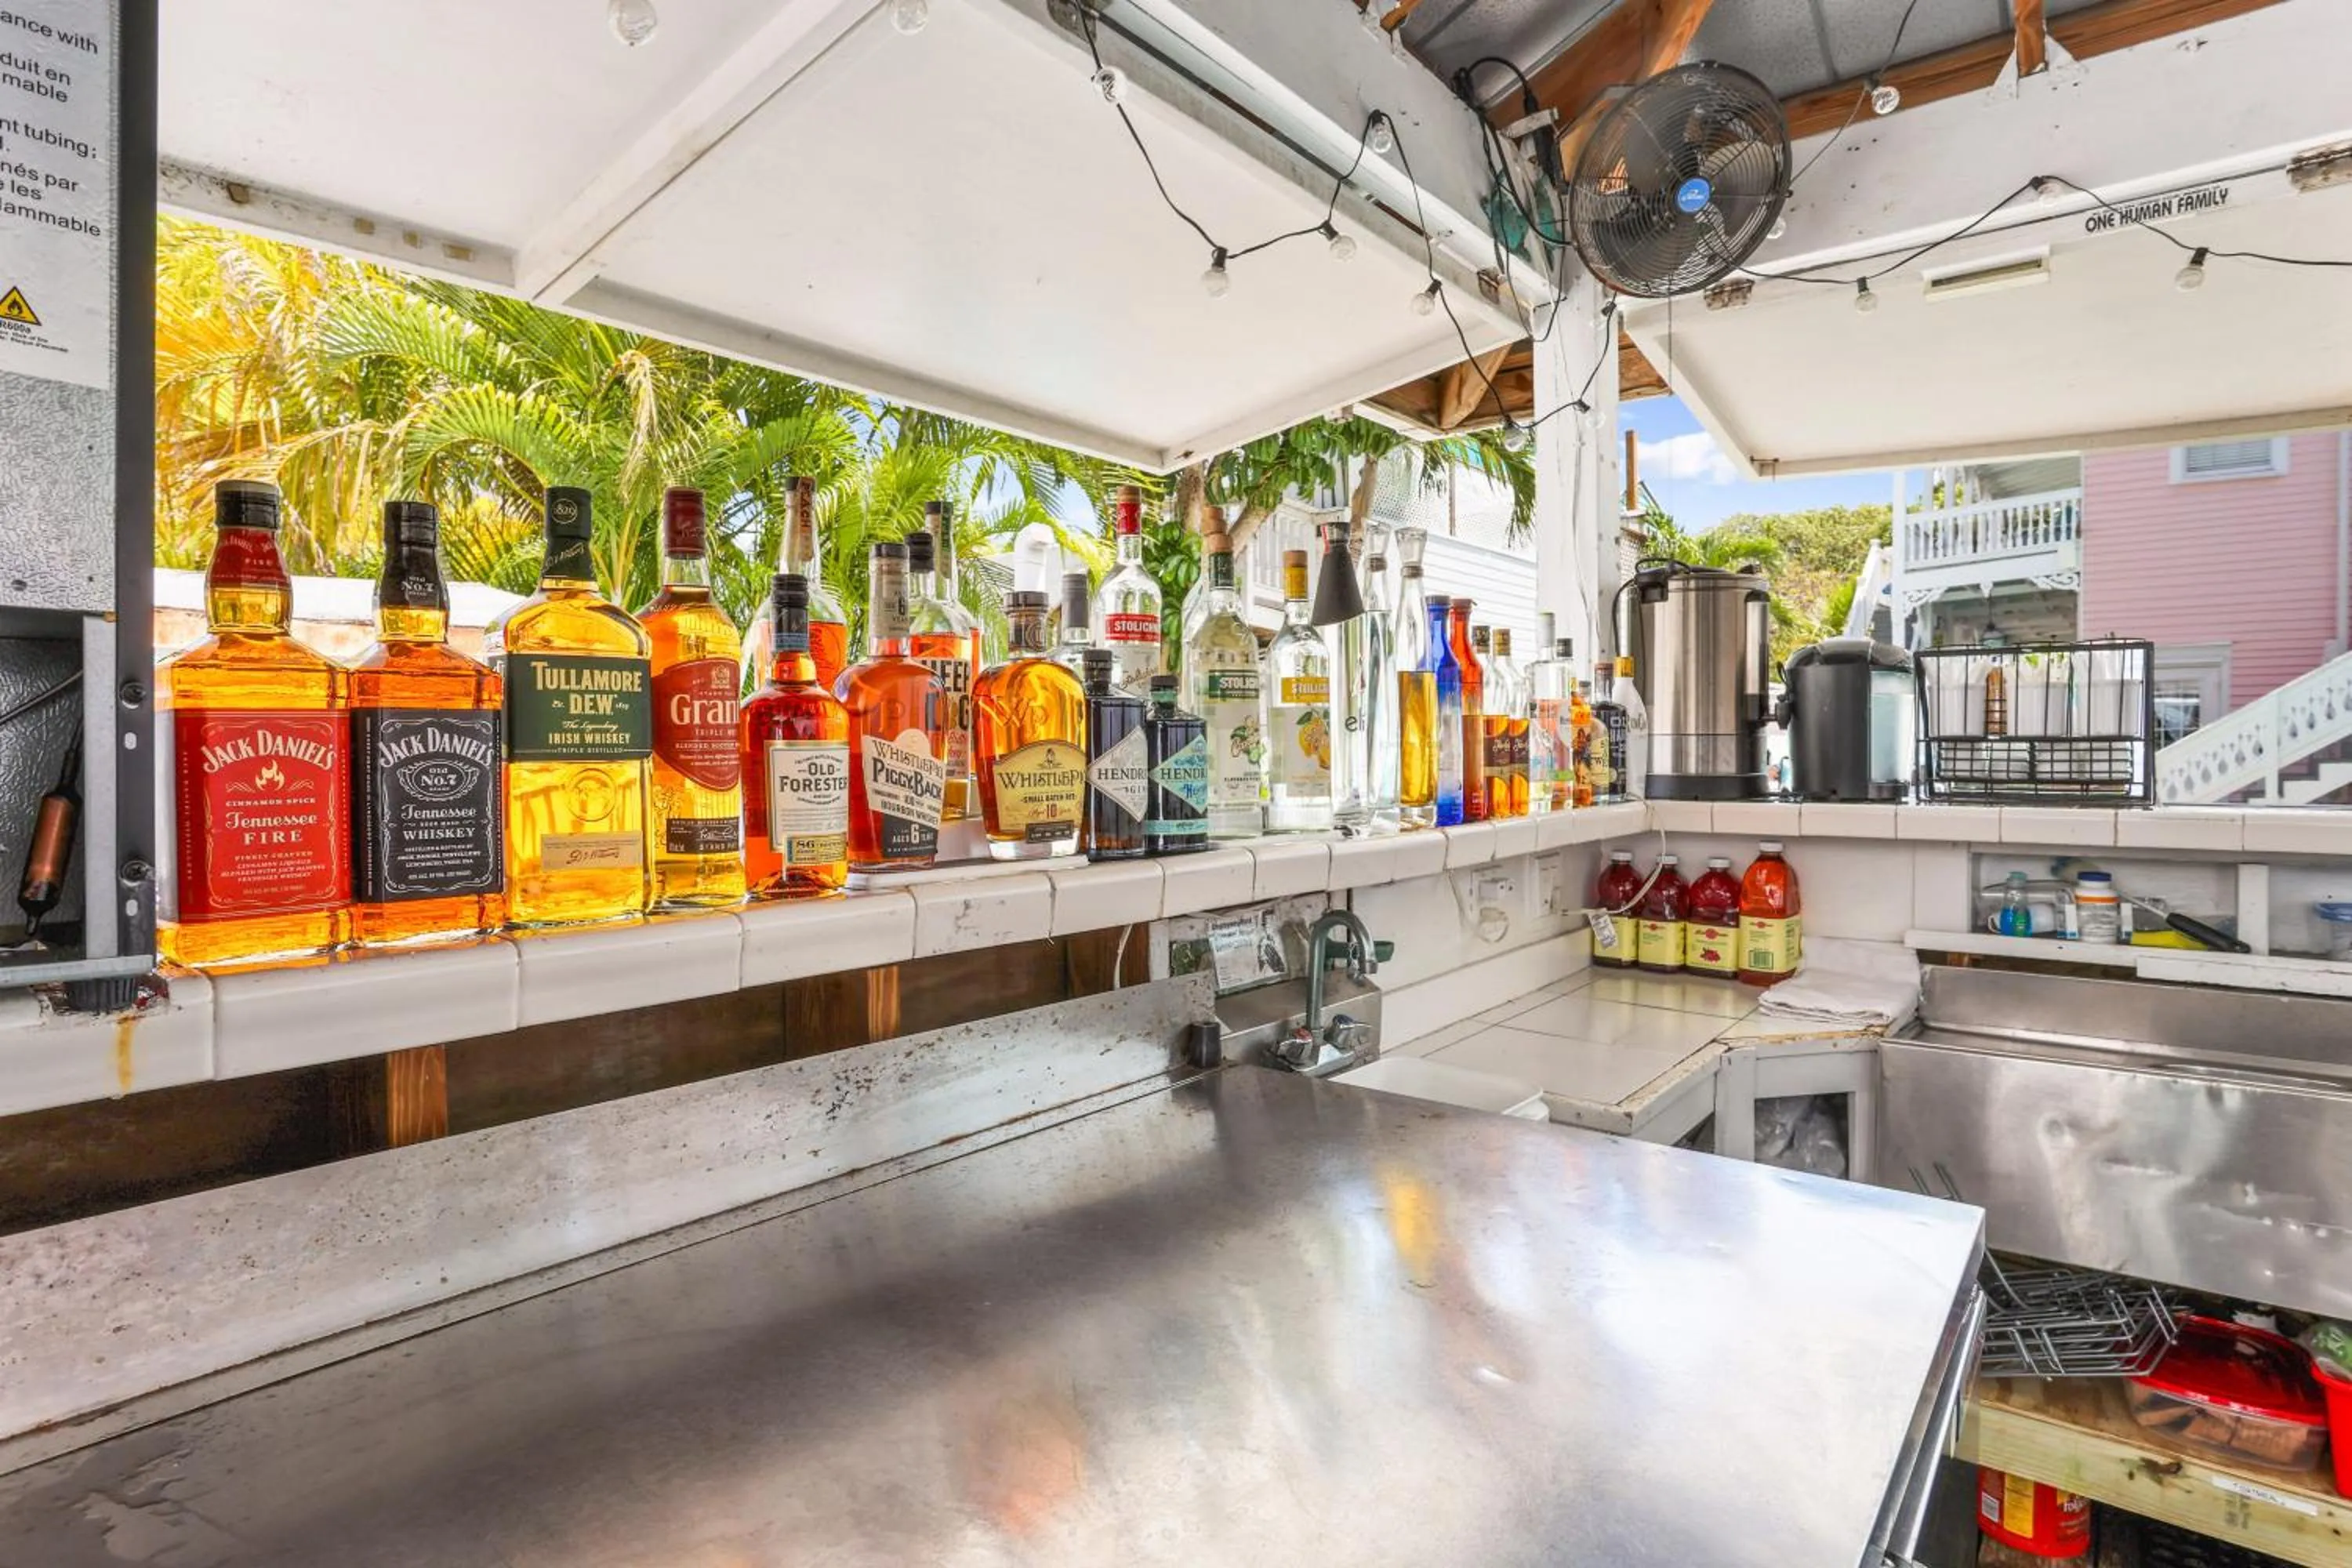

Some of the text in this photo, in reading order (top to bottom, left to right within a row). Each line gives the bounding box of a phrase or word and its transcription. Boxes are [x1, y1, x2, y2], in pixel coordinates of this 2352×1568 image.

[57, 30, 98, 55] with
[0, 52, 71, 86] duit en
[2, 72, 68, 103] mable
[24, 123, 96, 159] tubing:
[11, 180, 42, 201] les
[45, 173, 80, 192] par
[2085, 213, 2114, 233] ONE
[2119, 200, 2172, 226] HUMAN
[2177, 187, 2229, 214] FAMILY
[529, 660, 643, 693] TULLAMORE
[378, 727, 495, 768] JACK DANIEL'S
[549, 732, 631, 745] IRISH WHISKEY
[200, 728, 337, 773] JACK DANIEL'S
[808, 761, 836, 776] OLD
[420, 774, 458, 787] No.7
[996, 769, 1086, 790] WHISTLEPI
[225, 798, 283, 807] CINNAMON
[401, 803, 477, 820] Tennessee
[225, 811, 318, 829] Tennessee
[243, 829, 304, 846] FIRE
[403, 827, 476, 840] WHISKEY
[910, 823, 920, 845] 6
